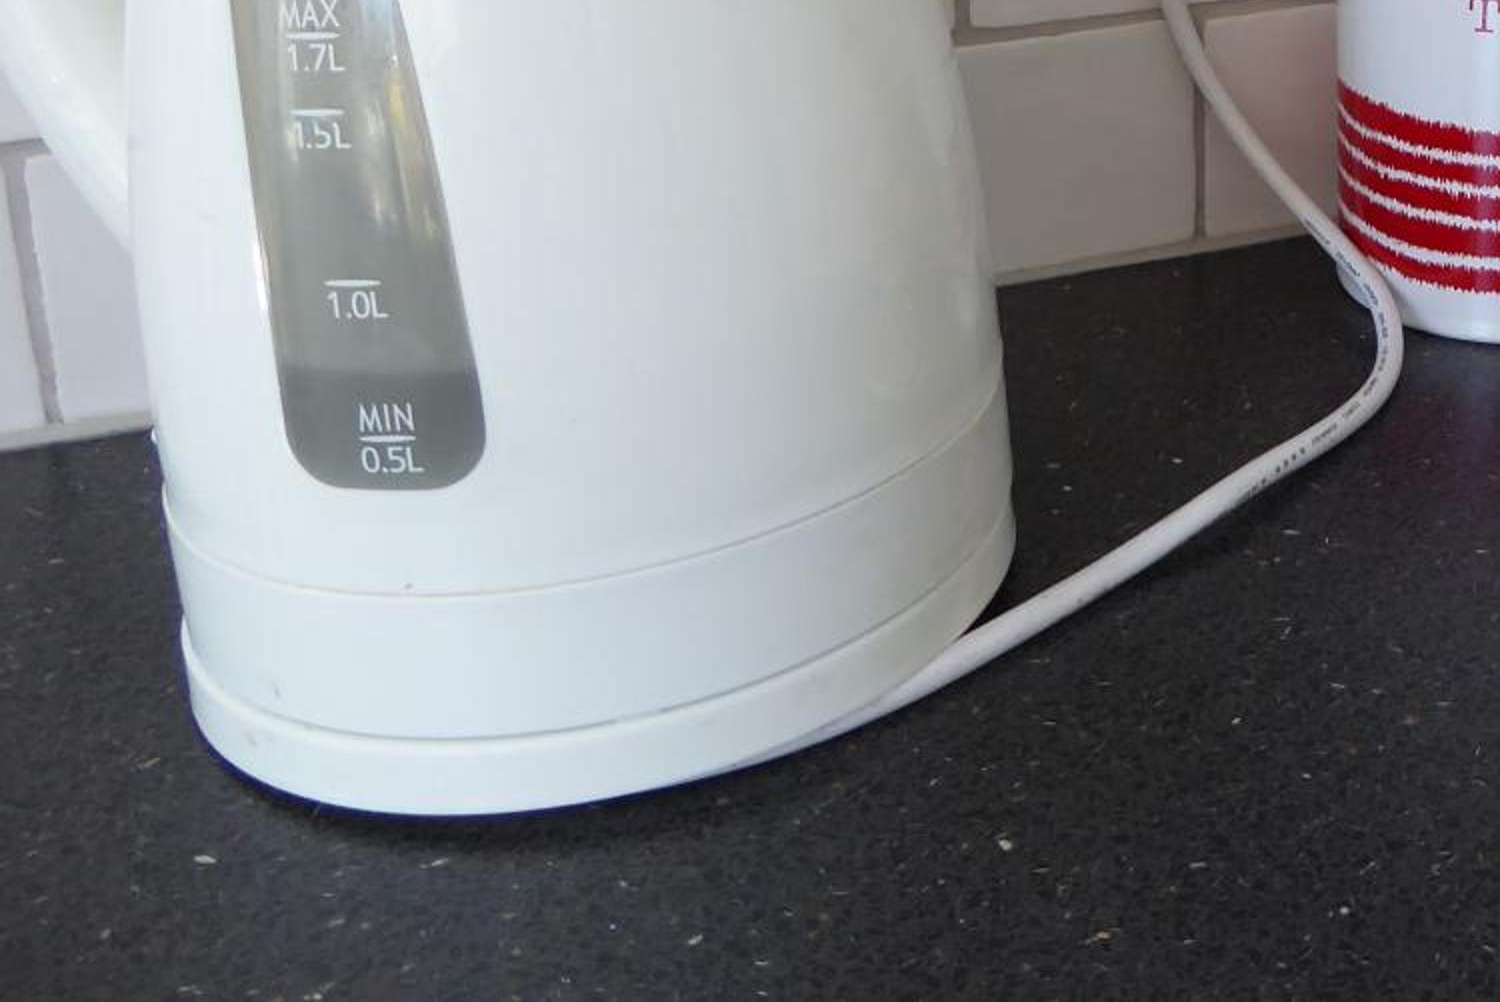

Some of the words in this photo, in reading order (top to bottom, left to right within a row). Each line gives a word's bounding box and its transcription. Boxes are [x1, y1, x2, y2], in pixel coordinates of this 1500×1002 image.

[286, 42, 346, 73] 1.7L
[327, 291, 390, 319] 1.0L
[358, 403, 416, 433] MIN
[361, 445, 425, 474] 0.5L
